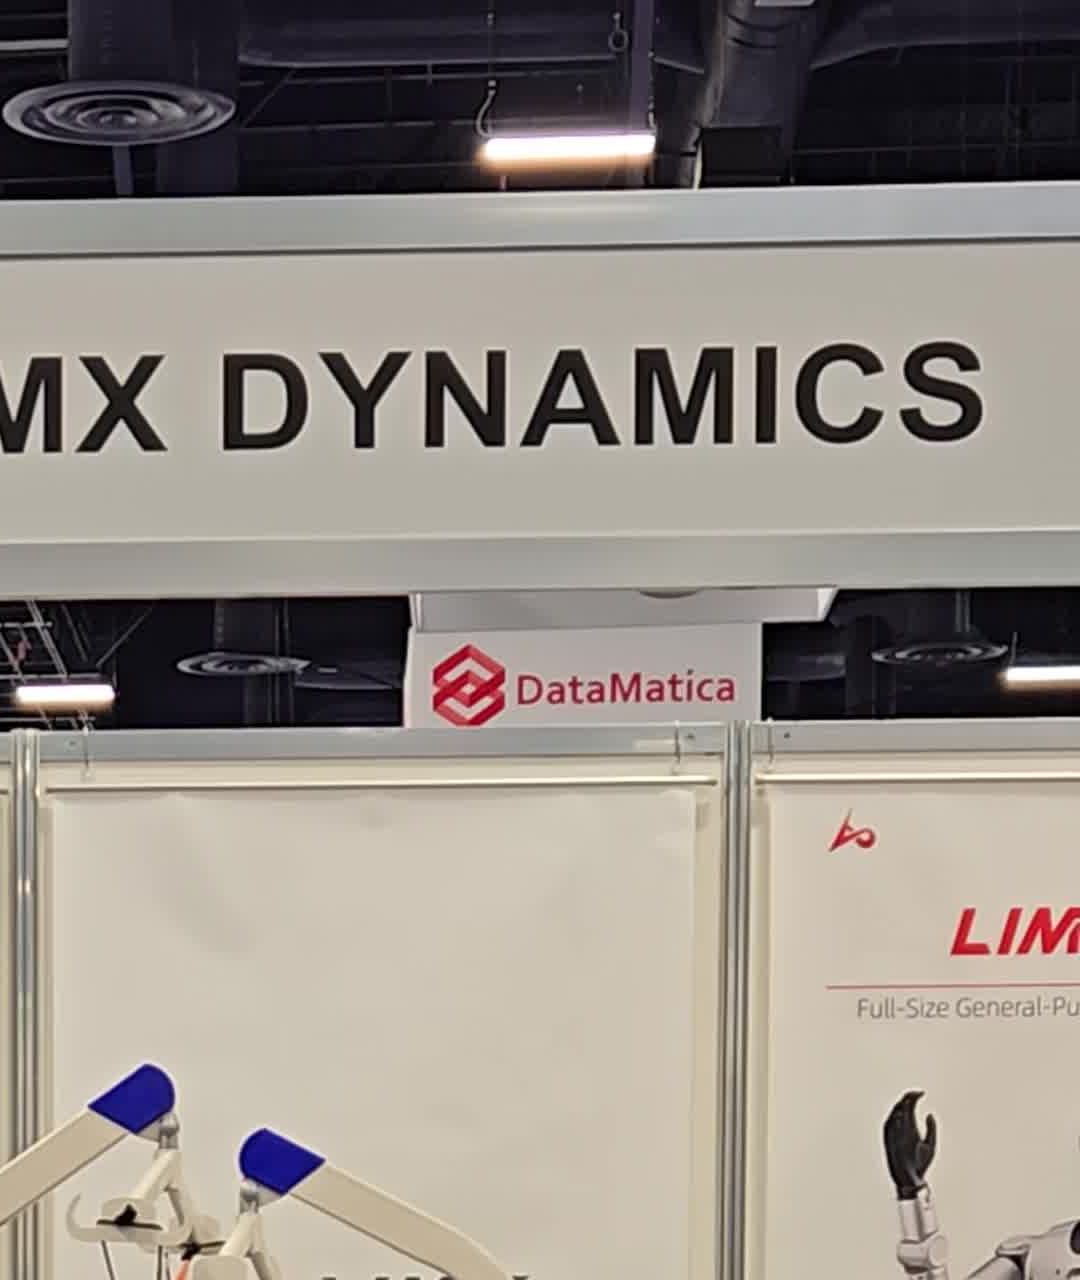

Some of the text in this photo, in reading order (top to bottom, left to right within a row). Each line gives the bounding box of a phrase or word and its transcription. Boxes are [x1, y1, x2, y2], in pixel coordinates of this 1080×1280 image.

[223, 342, 983, 451] DYNAMICS
[517, 669, 735, 705] DataMatica
[857, 997, 950, 1019] Full-Size
